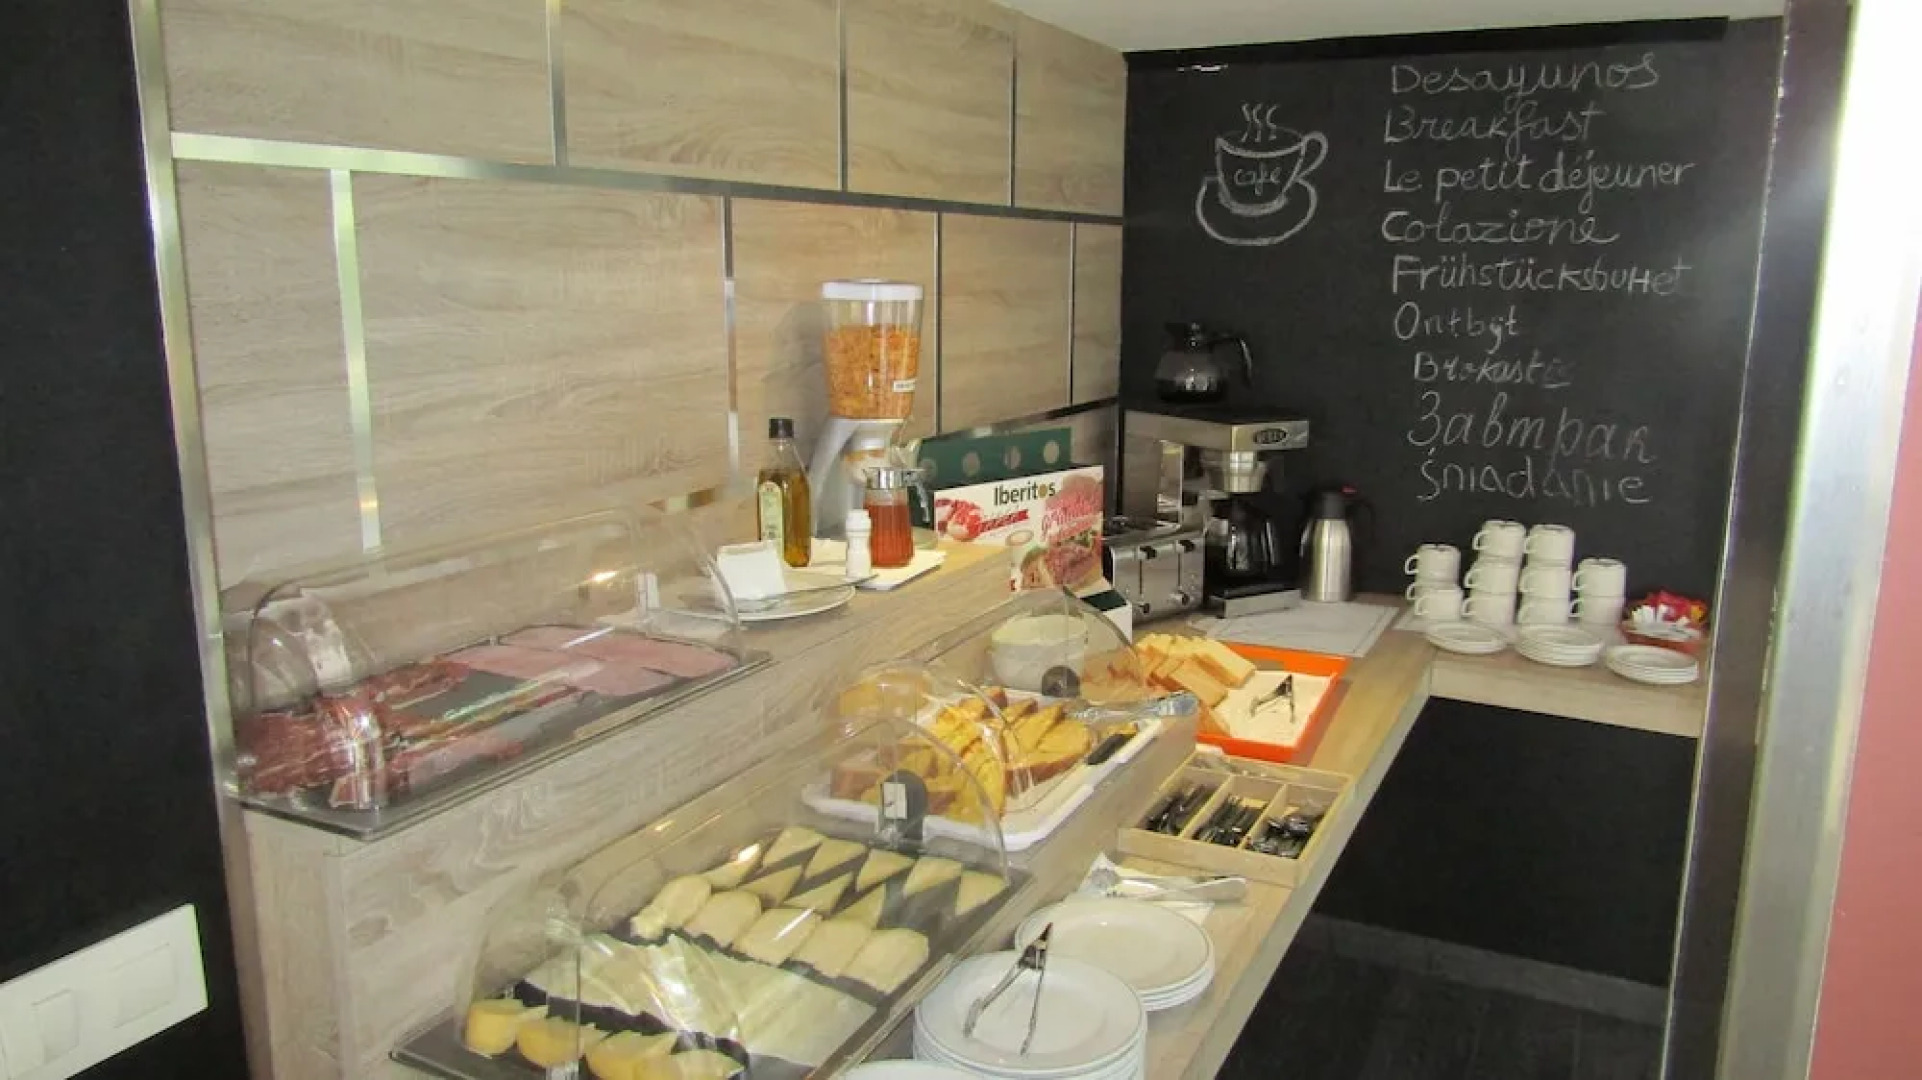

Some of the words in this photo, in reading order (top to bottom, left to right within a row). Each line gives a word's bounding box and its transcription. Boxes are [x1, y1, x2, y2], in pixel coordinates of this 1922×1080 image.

[1391, 52, 1660, 114] Desayunos
[1384, 101, 1606, 161] Breakfast
[1384, 159, 1423, 193] Le
[1435, 154, 1532, 202] petit
[1538, 150, 1696, 214] déjeuner
[1381, 202, 1621, 245] Colazione
[993, 481, 1057, 507] Iberitos
